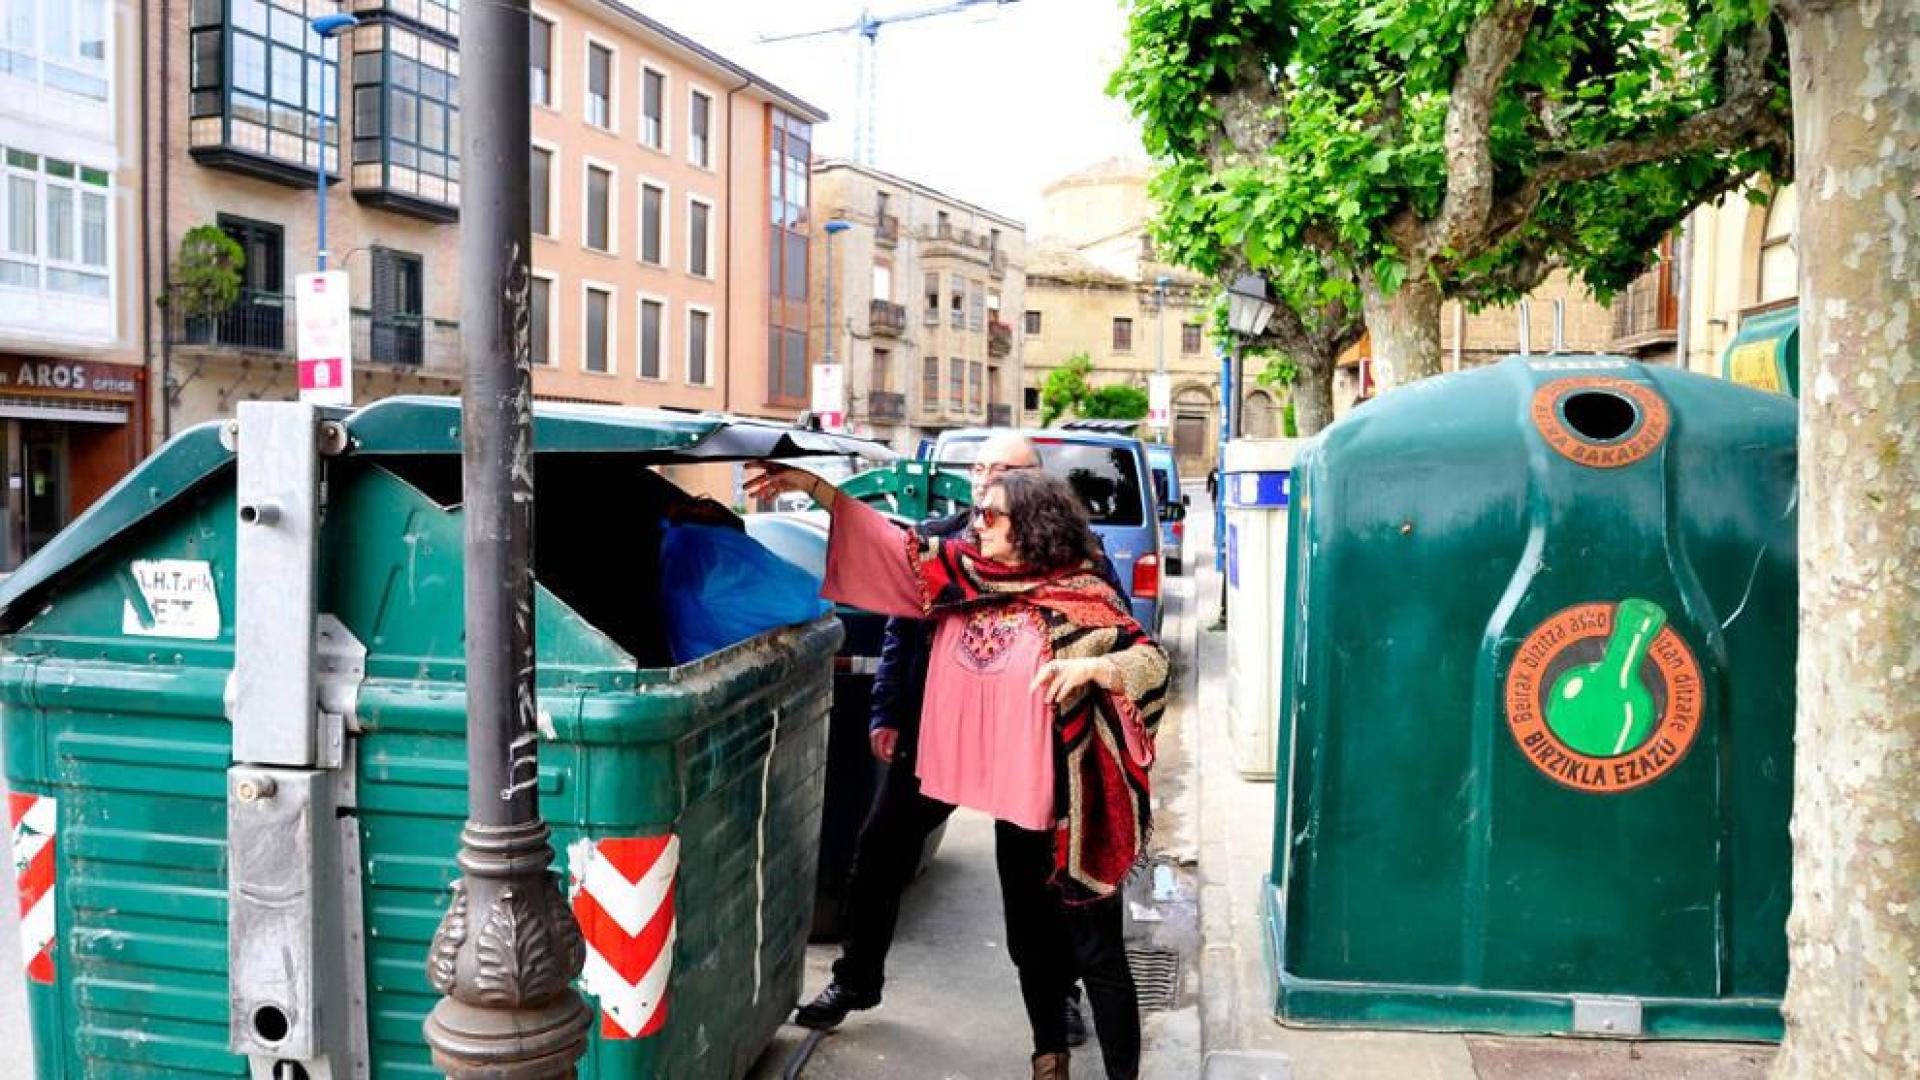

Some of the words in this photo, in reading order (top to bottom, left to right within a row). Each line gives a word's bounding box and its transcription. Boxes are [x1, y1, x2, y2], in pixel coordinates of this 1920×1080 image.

[17, 361, 86, 389] AROS
[1523, 730, 1607, 786] BIRZIKLA
[1613, 736, 1678, 784] EZAZU
